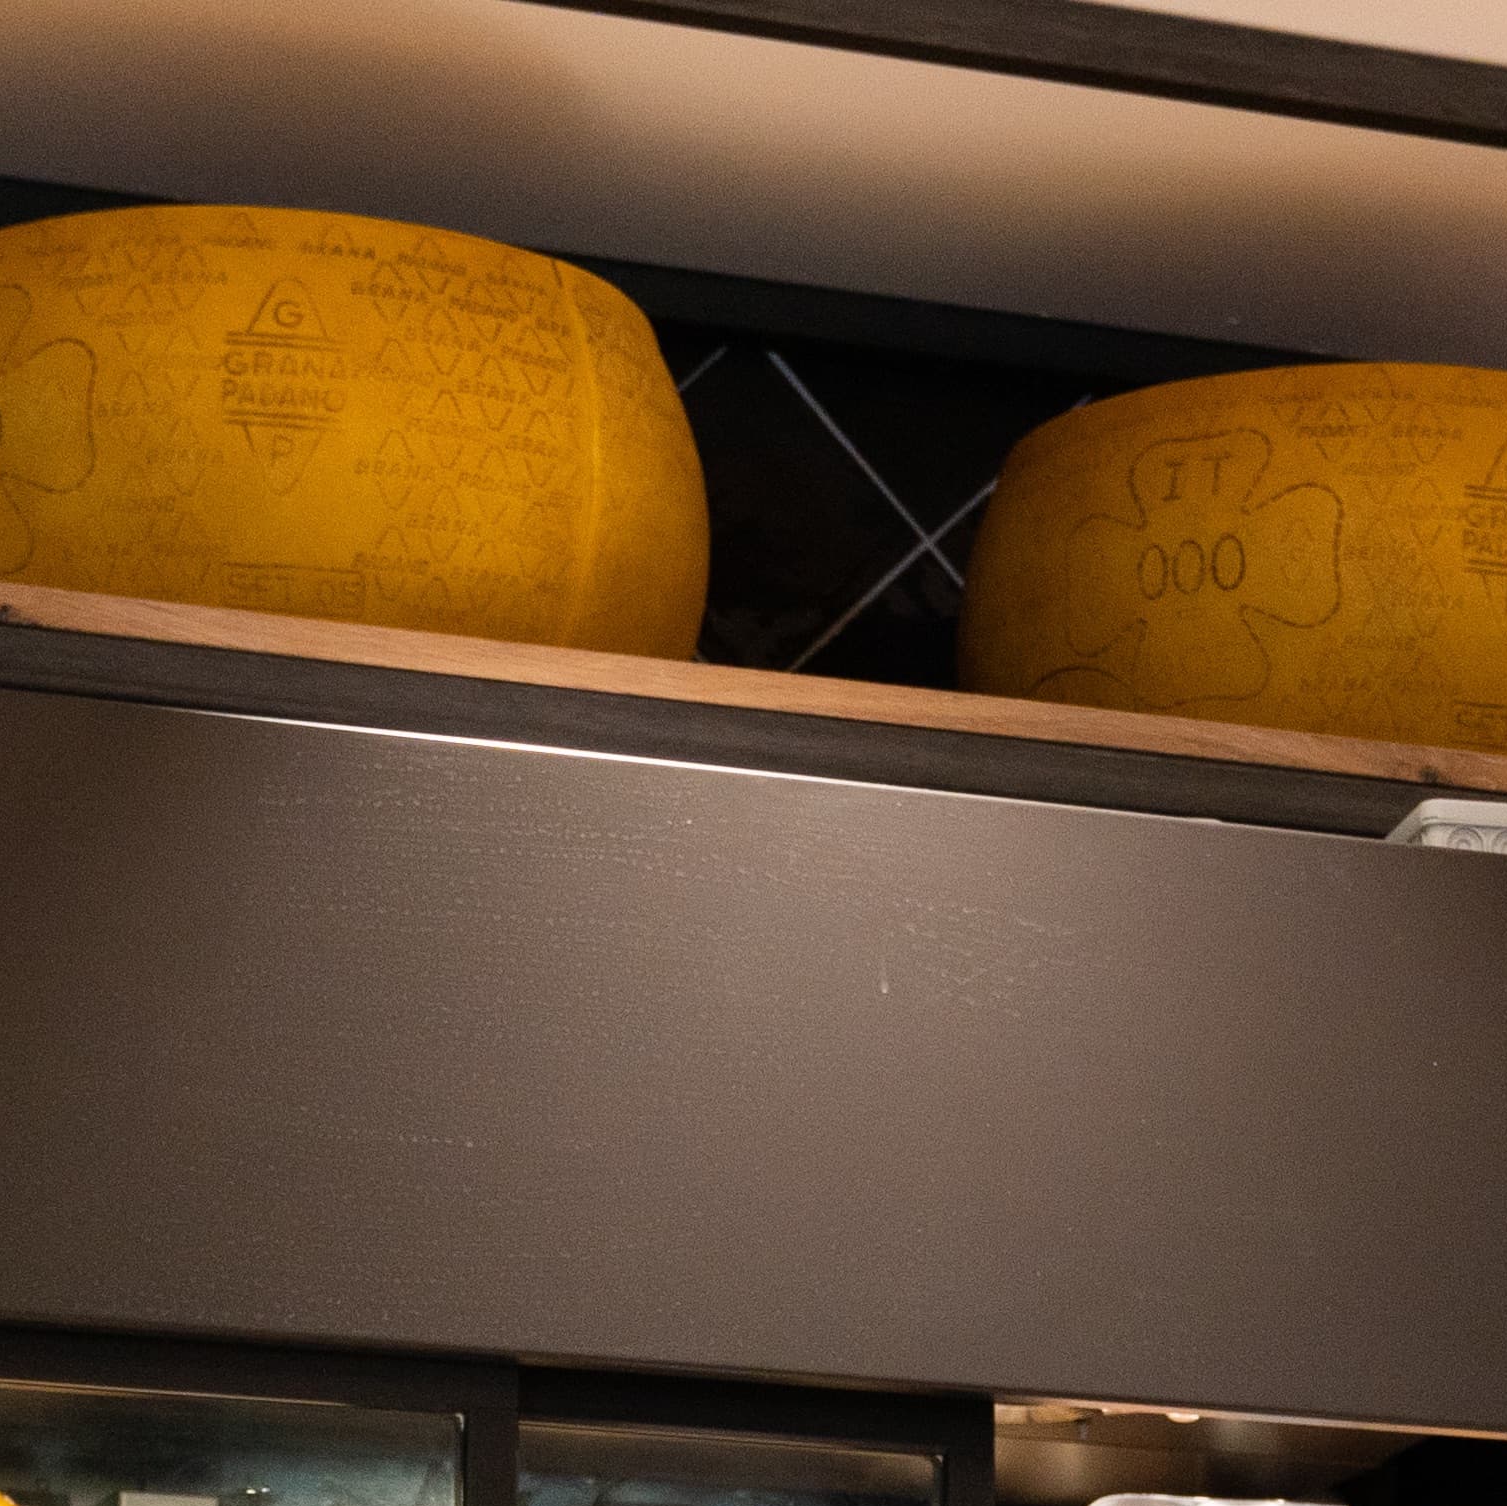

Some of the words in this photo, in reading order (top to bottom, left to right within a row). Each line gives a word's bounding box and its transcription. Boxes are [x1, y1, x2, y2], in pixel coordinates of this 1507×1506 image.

[222, 349, 349, 383] GRANA
[221, 378, 347, 413] PADANO
[1137, 531, 1247, 602] 000
